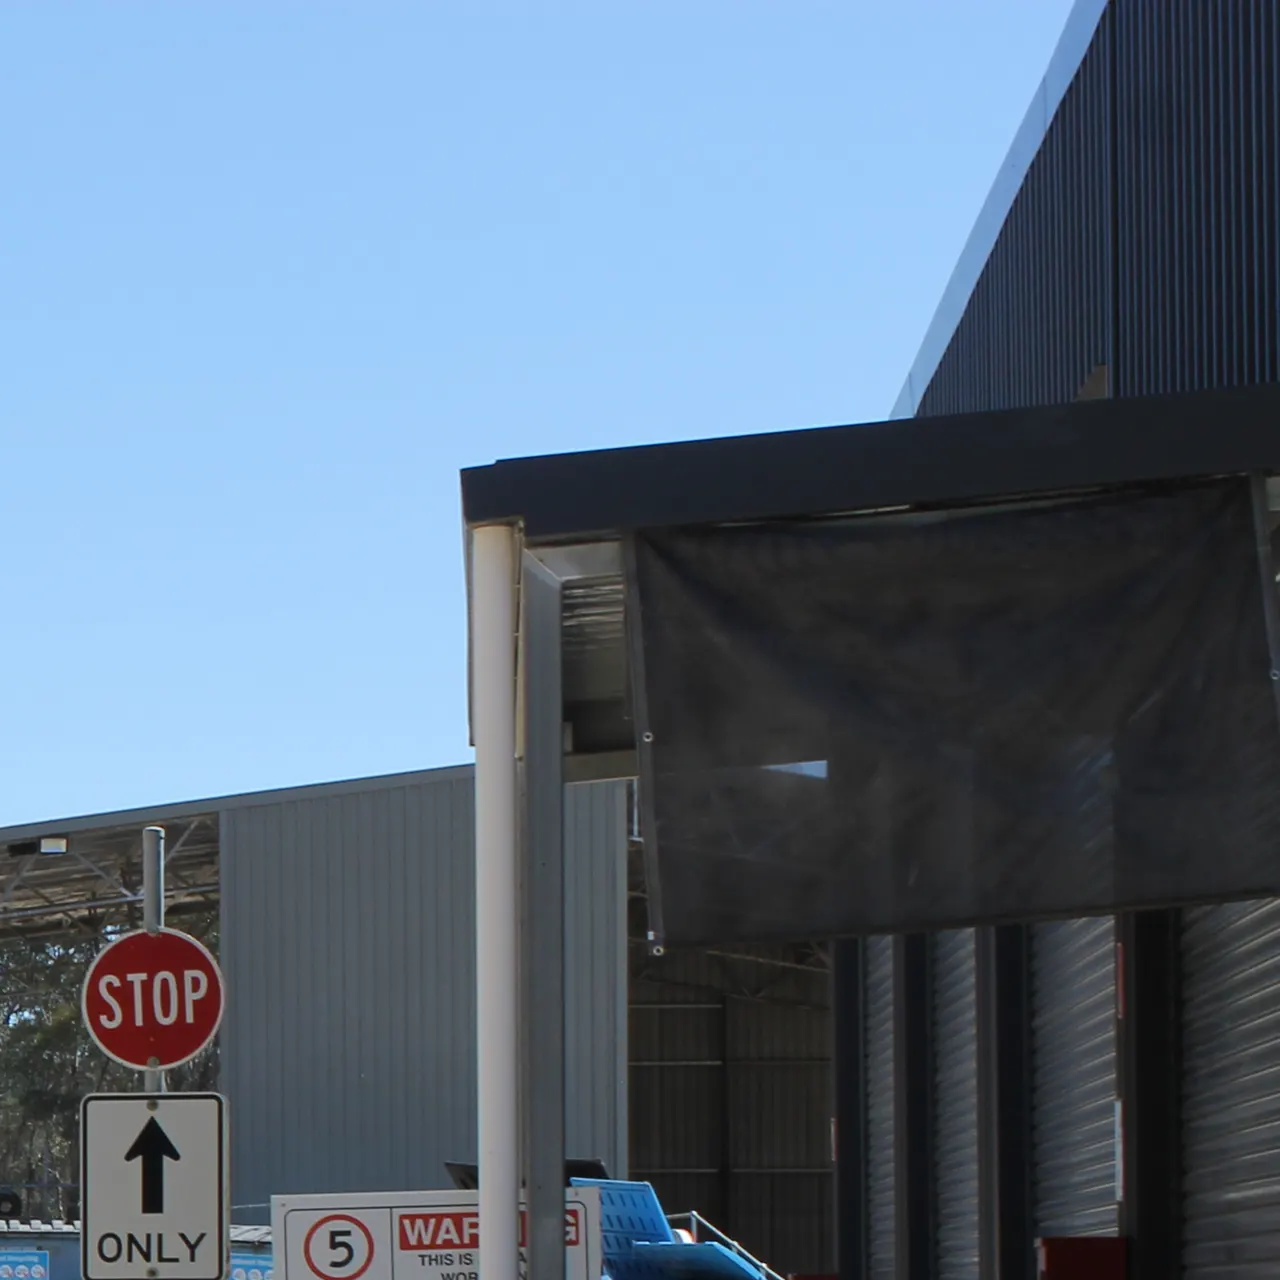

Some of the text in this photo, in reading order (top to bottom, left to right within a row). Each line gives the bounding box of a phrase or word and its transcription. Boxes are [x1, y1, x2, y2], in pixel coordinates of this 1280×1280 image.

[98, 970, 208, 1029] STOP
[98, 1233, 206, 1262] ONLY
[329, 1230, 354, 1268] 5
[418, 1253, 473, 1266] THIS IS
